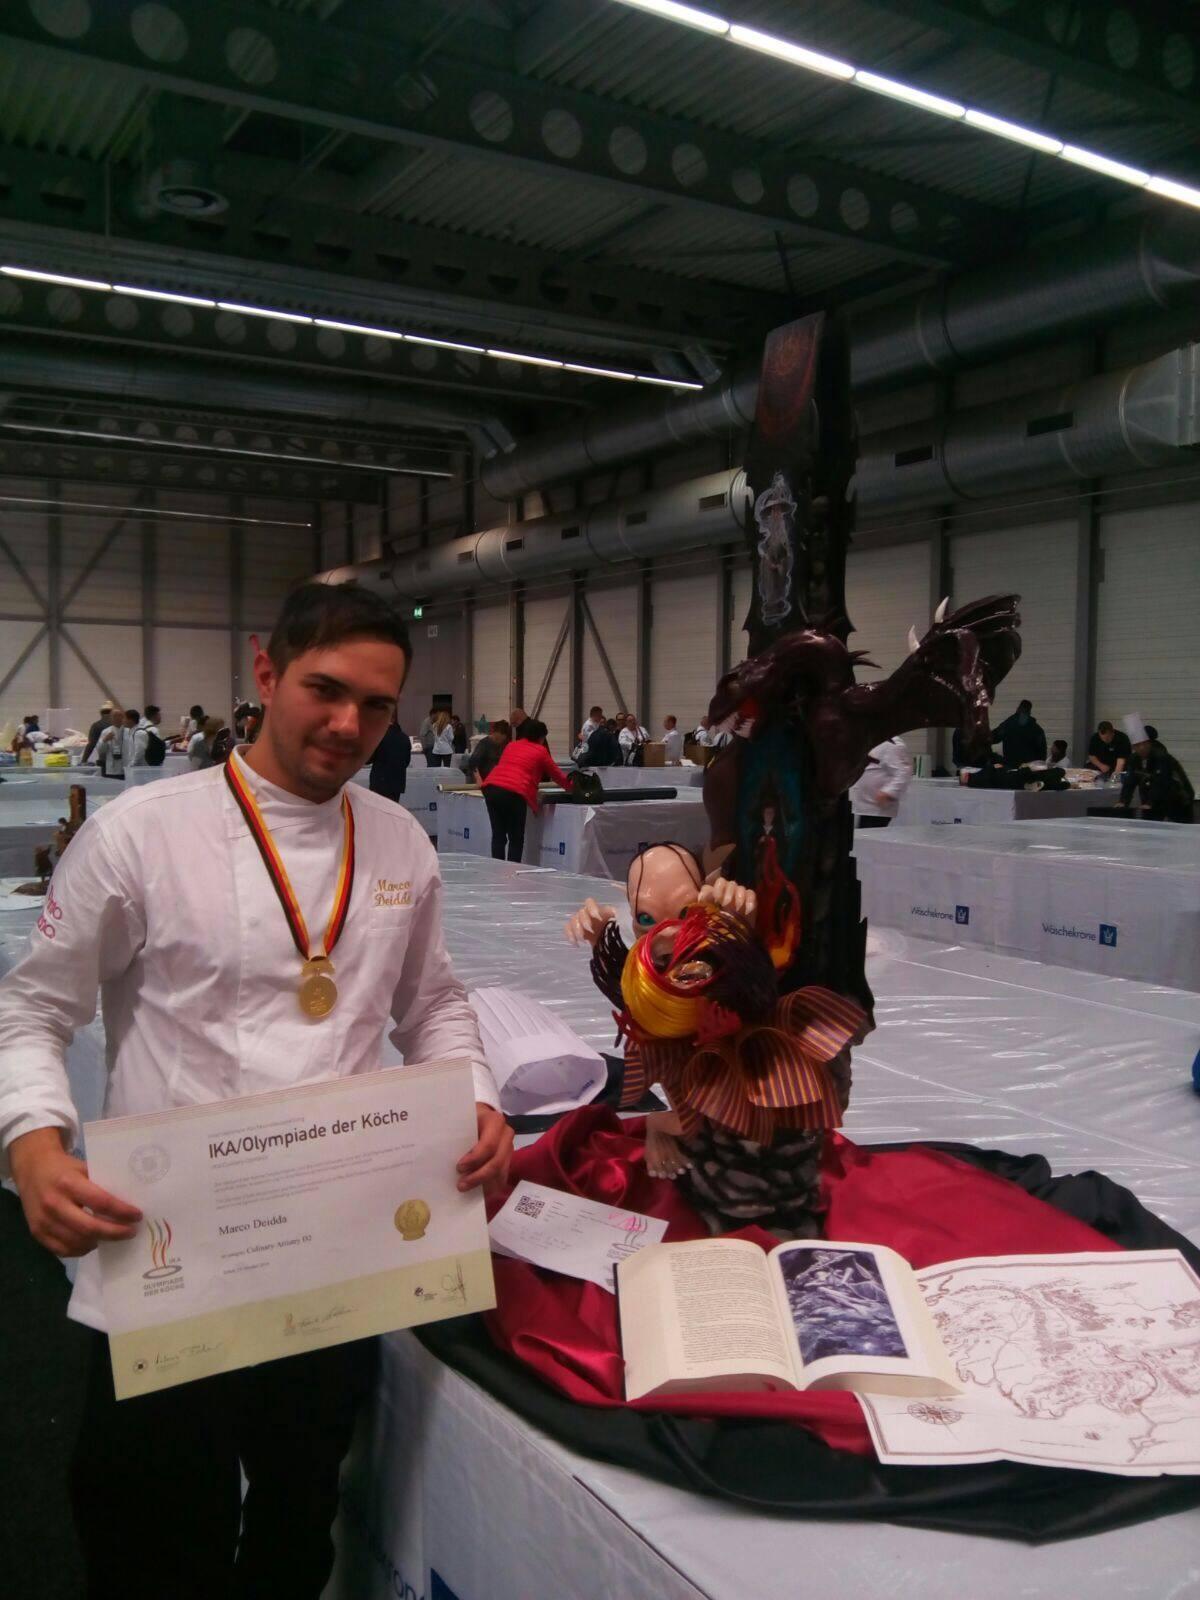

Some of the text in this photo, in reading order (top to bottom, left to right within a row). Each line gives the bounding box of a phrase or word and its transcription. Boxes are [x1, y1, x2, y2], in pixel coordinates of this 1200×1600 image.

[375, 879, 410, 892] Marco
[208, 1124, 327, 1159] IKA/Olympiade
[331, 1119, 358, 1136] der
[361, 1108, 409, 1129] Köche
[218, 1215, 288, 1236] Marco Deidda
